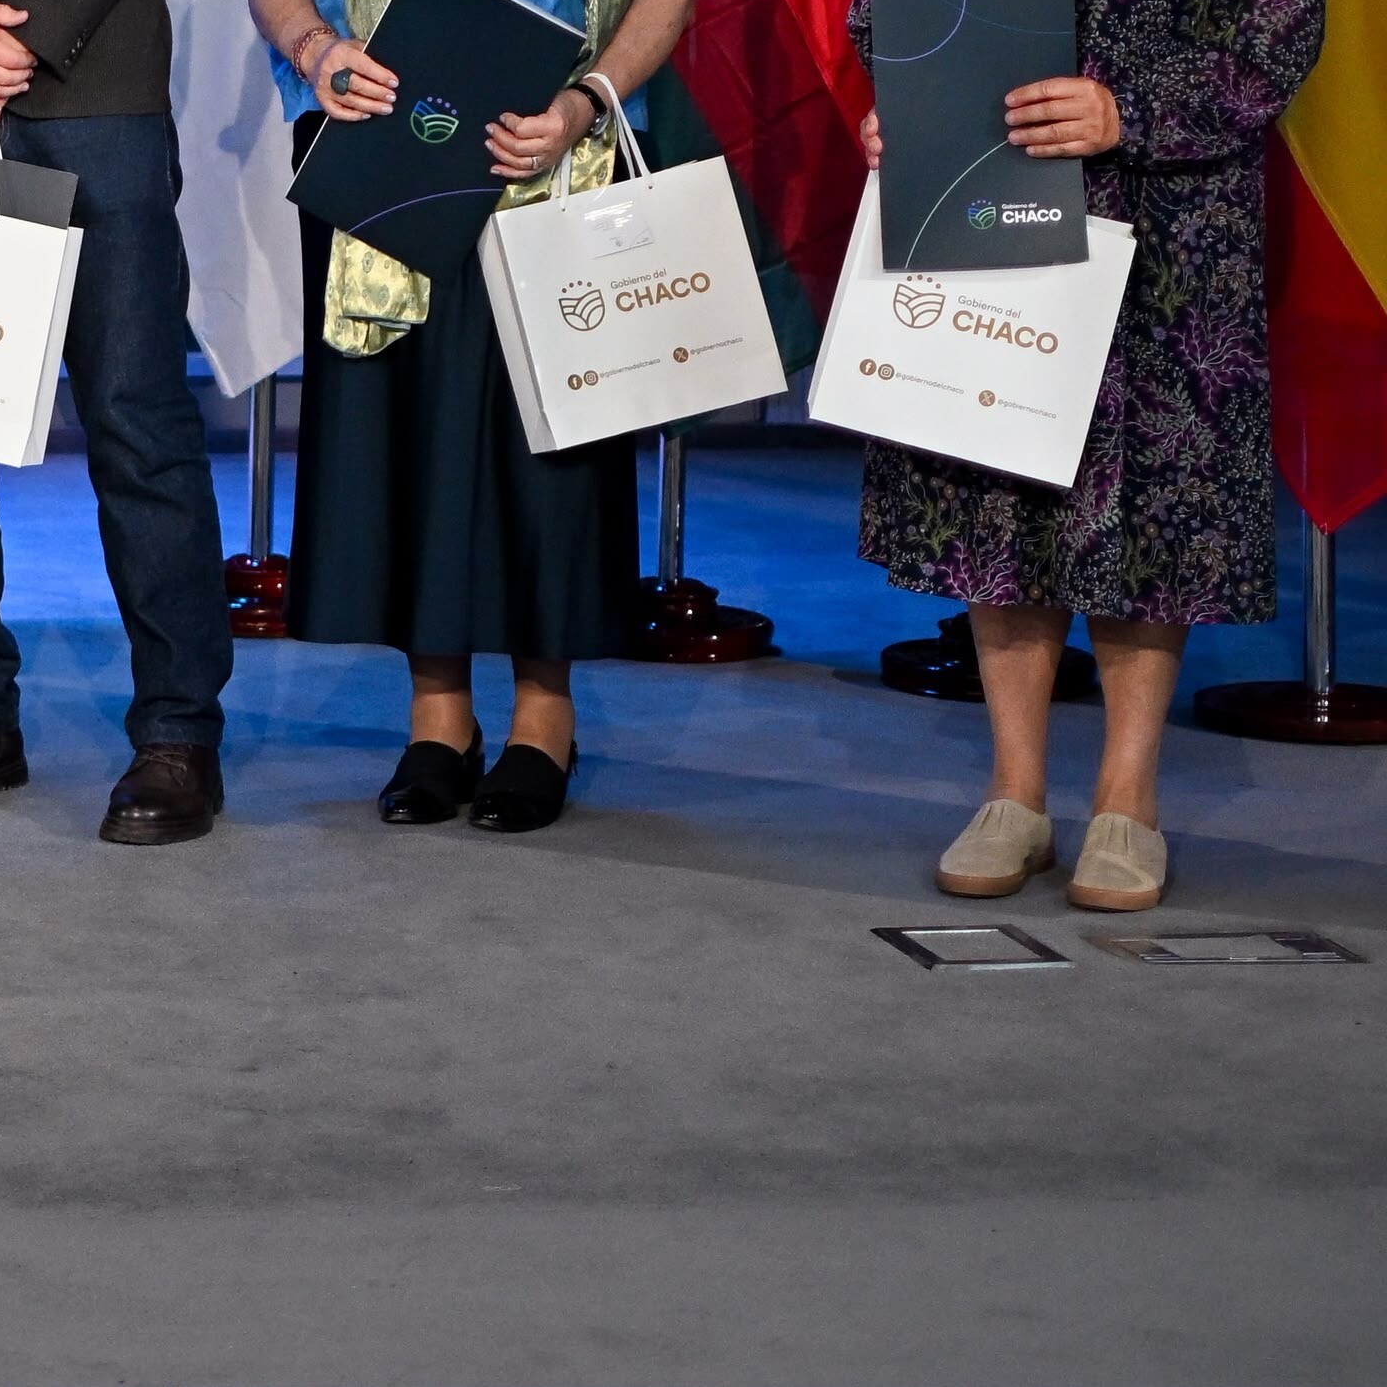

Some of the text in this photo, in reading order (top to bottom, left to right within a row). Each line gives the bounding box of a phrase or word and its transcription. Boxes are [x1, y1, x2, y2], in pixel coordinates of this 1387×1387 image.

[1002, 208, 1063, 224] CHACO
[610, 268, 667, 290] Gobierno del
[615, 272, 711, 312] CHACO
[957, 295, 1022, 319] Gobierno del
[952, 310, 1059, 354] CHACO
